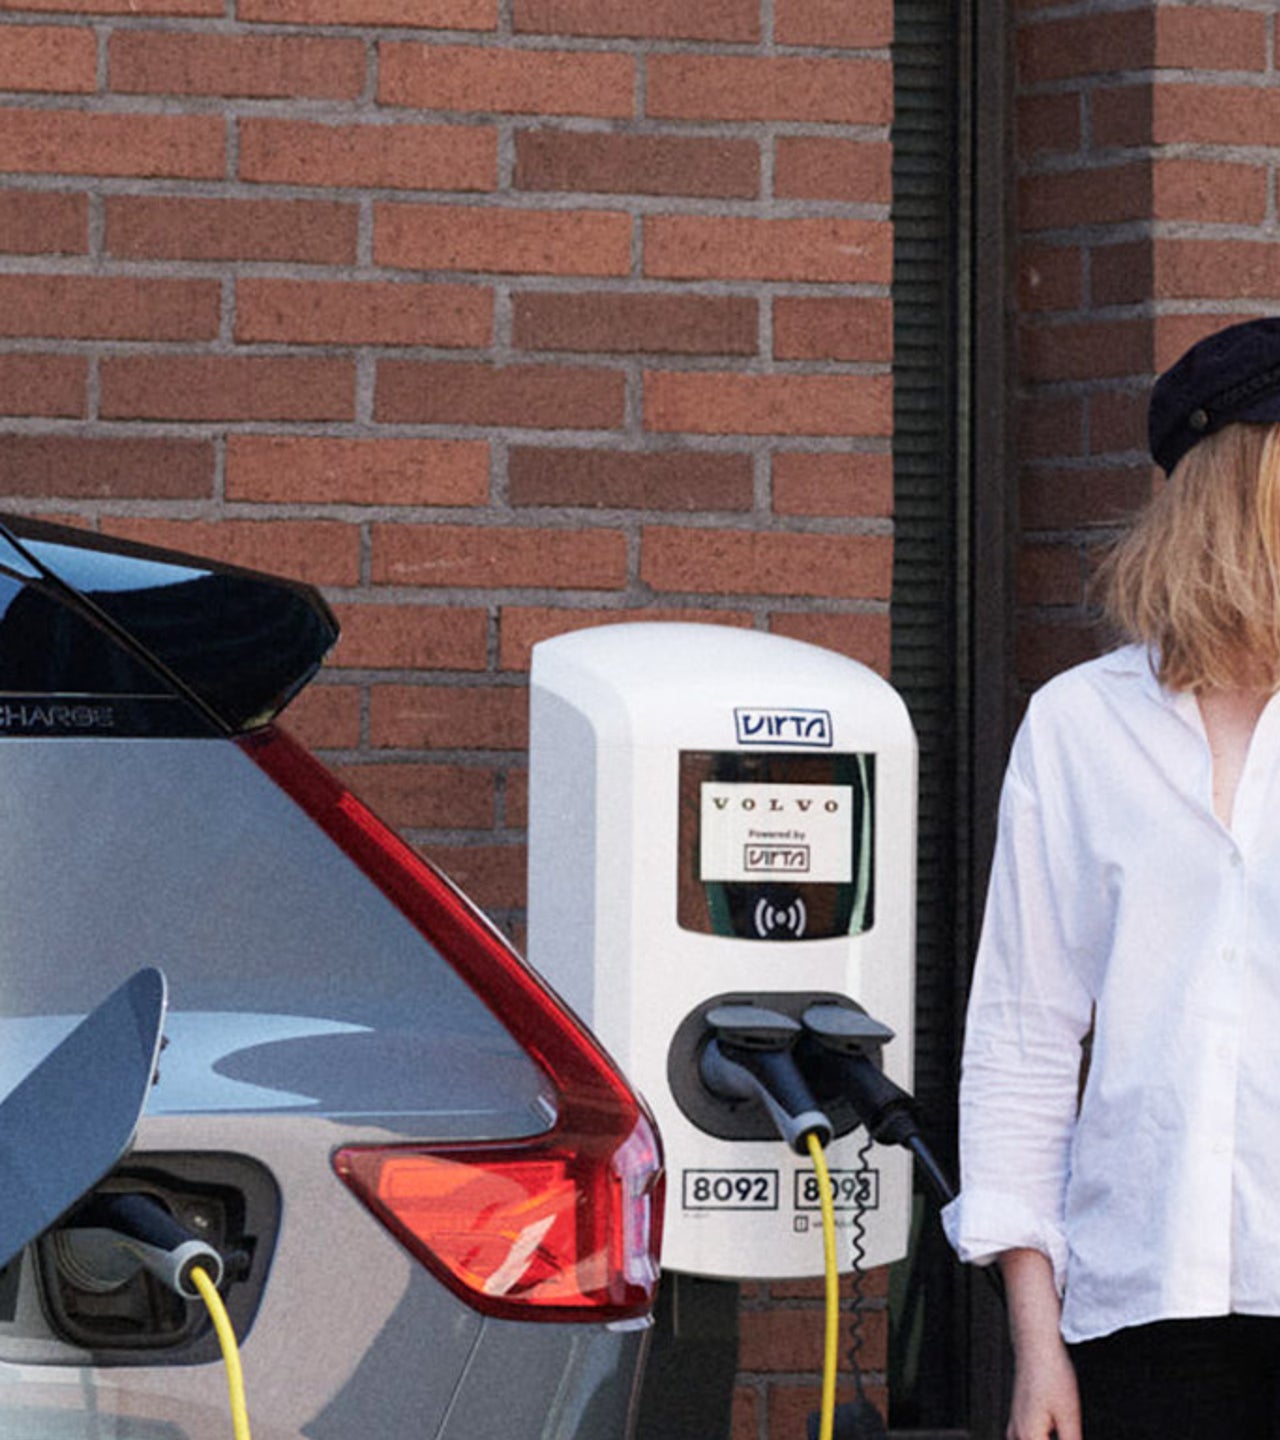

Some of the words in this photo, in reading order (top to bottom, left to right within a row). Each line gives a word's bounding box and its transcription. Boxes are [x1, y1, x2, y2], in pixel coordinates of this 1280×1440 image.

[0, 704, 115, 728] HARGE
[712, 797, 839, 813] VOLVO
[748, 829, 791, 839] Powered
[793, 830, 806, 841] by
[693, 1177, 769, 1202] 8092
